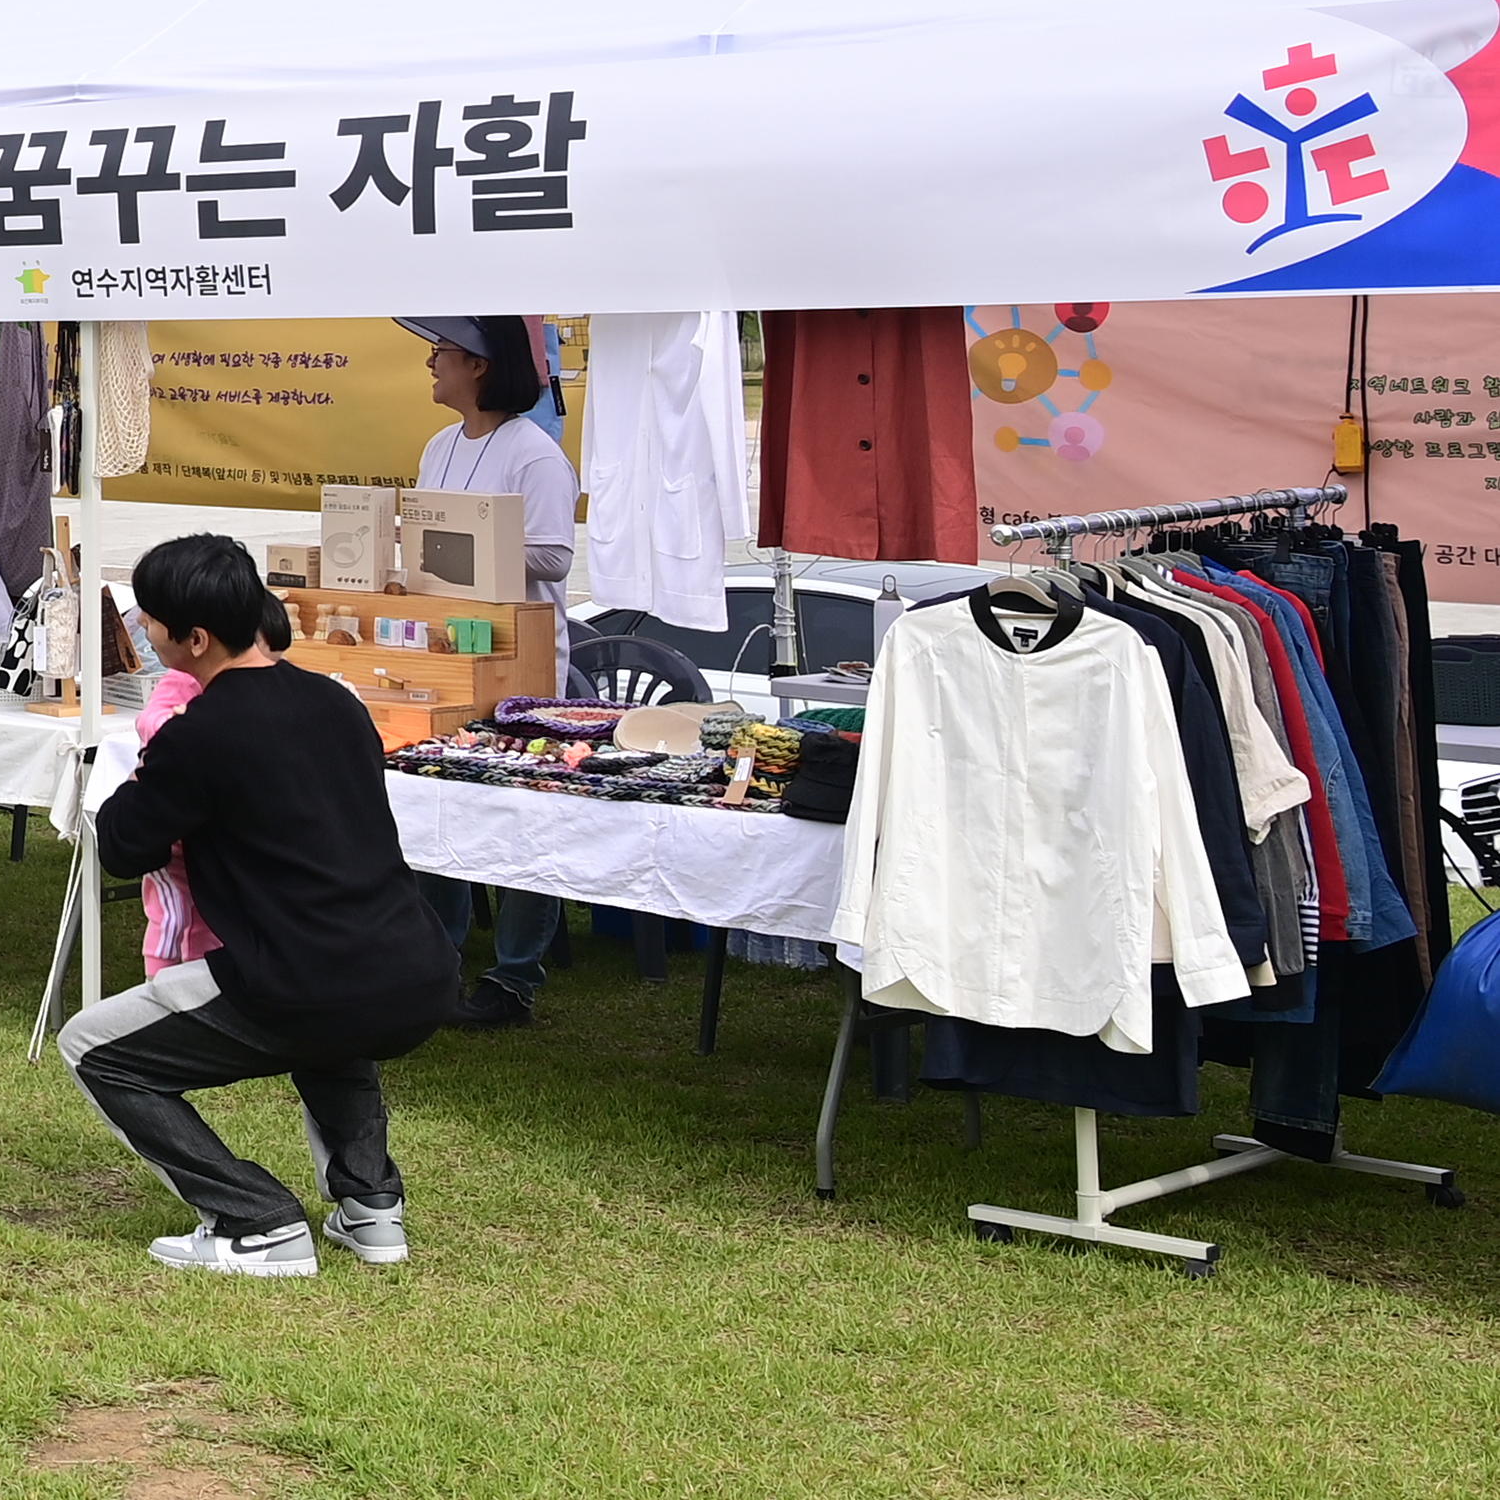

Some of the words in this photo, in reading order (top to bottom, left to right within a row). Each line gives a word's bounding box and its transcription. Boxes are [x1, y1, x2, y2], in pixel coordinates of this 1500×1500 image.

[330, 92, 587, 236] 자활
[71, 263, 272, 298] 연수지역자활센터
[169, 352, 216, 367] 실생활에
[220, 351, 255, 368] 필요한
[259, 353, 283, 369] 각종
[286, 352, 349, 369] 생활소품과
[215, 389, 264, 405] 서비스를
[268, 392, 335, 406] 제공합니다.
[1414, 408, 1476, 428] 사람과
[1368, 439, 1414, 458] 양한
[153, 462, 172, 475] 제작
[181, 464, 249, 483] 단체복(앞치마
[251, 469, 266, 484] 등)
[269, 471, 280, 484] 및
[282, 471, 313, 486] 기념품
[316, 474, 360, 487] 주문제작
[1434, 544, 1476, 565] 공간
